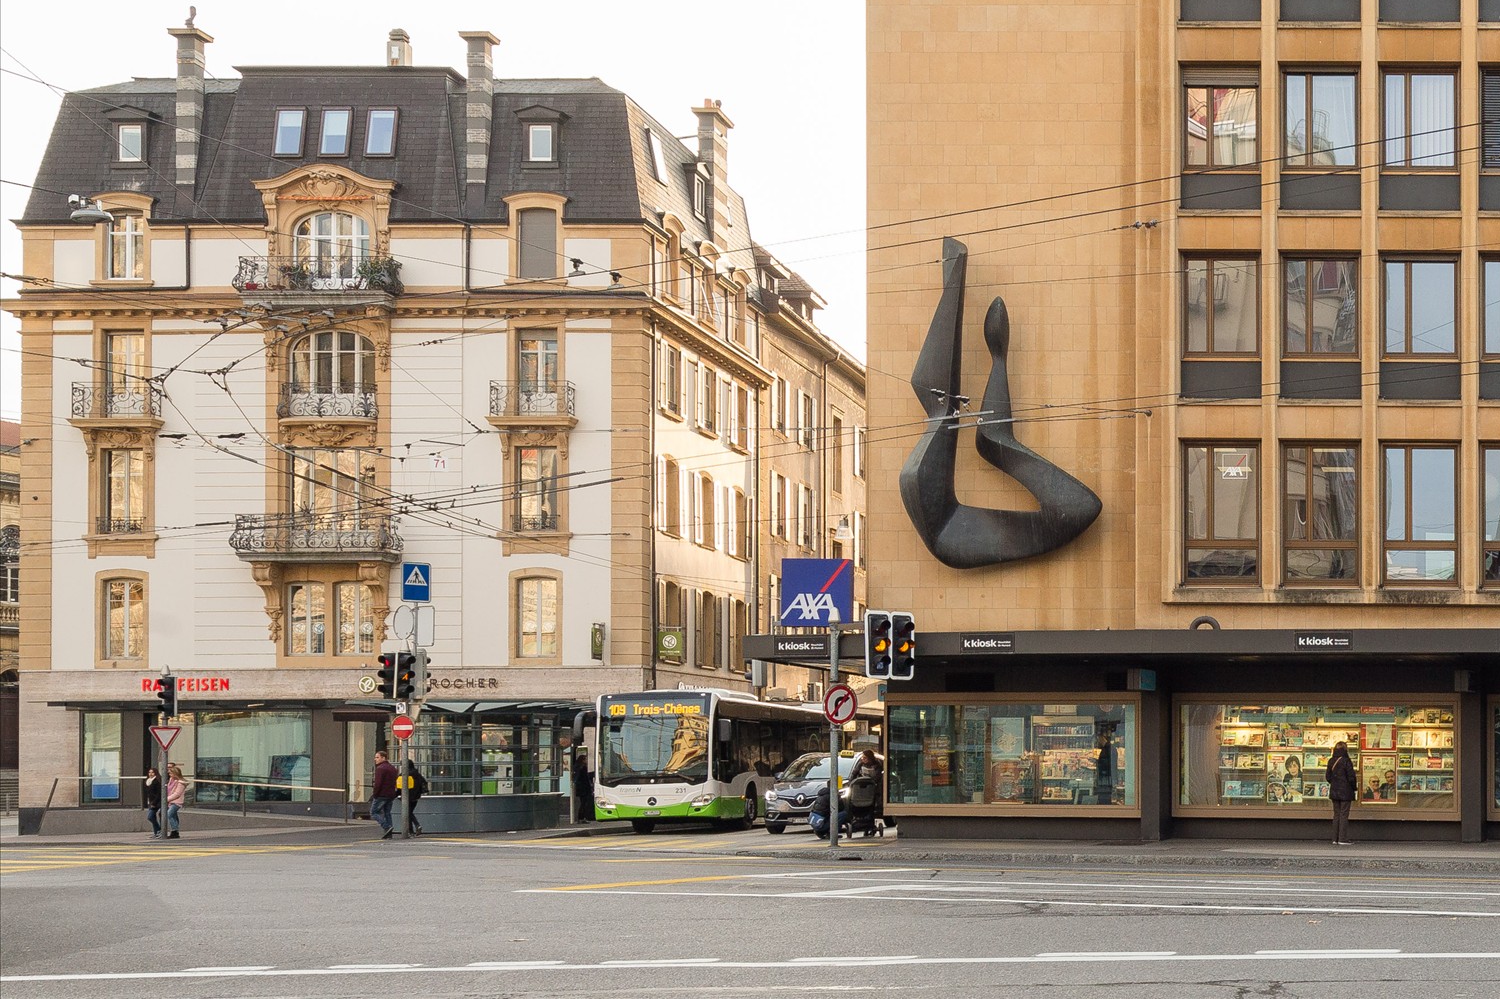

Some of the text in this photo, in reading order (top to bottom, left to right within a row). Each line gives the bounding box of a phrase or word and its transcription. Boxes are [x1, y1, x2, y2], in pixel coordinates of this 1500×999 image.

[780, 593, 837, 621] AXA
[785, 641, 810, 650] kiosk
[971, 639, 997, 648] kiosk
[1306, 636, 1334, 646] kiosk
[141, 678, 230, 692] RAFEISEN
[429, 678, 499, 690] ROCHER
[608, 702, 702, 716] 109 Trois-Chênes
